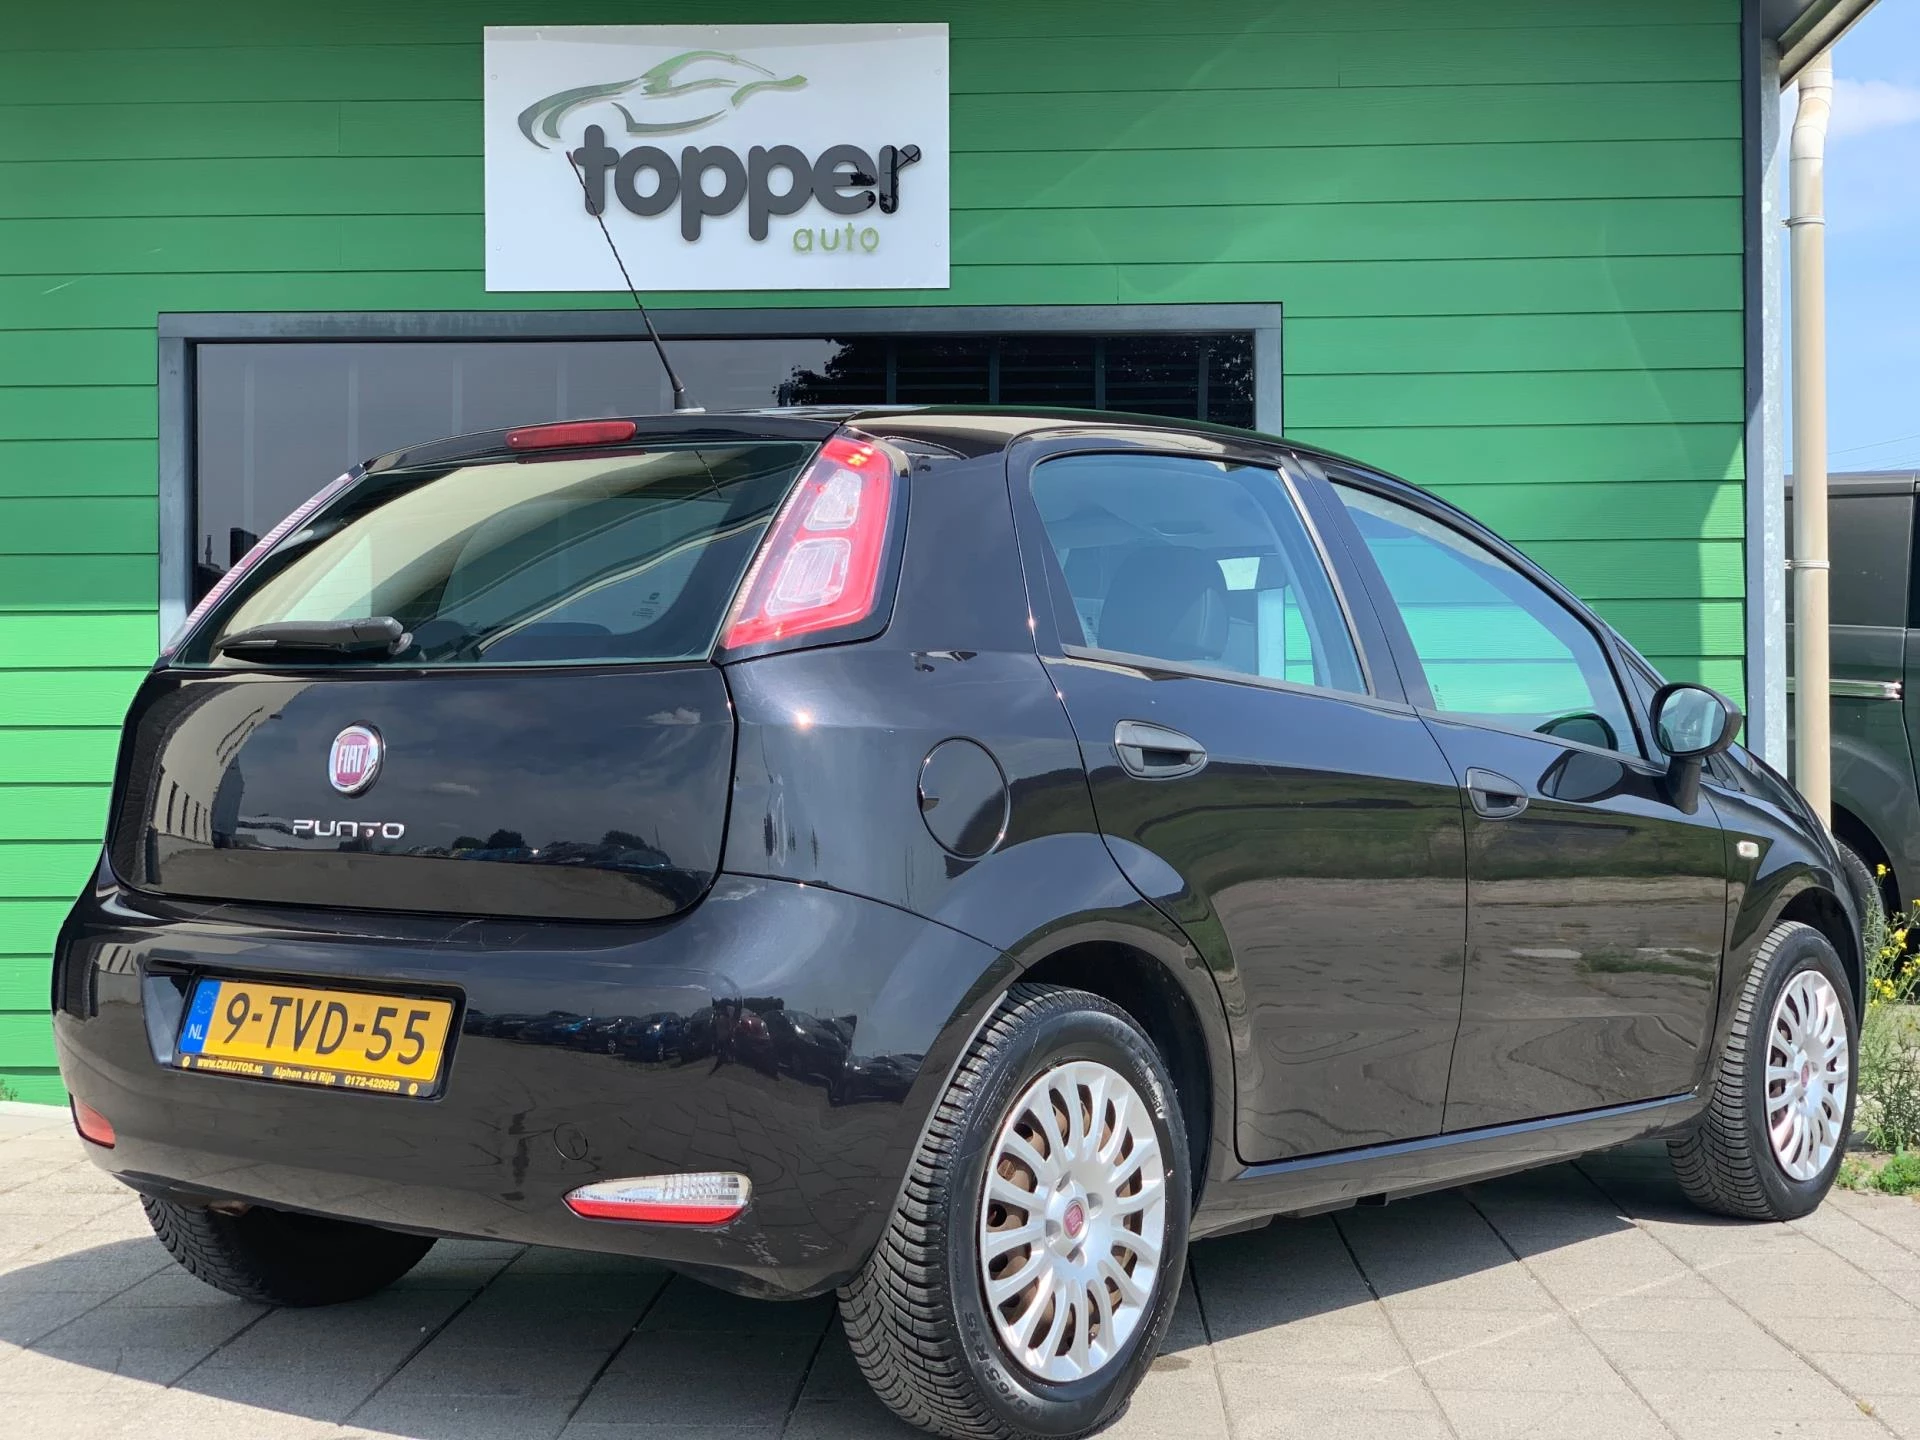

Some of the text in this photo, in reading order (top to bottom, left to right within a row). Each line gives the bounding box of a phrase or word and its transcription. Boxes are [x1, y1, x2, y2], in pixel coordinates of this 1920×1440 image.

[573, 124, 922, 242] topper
[793, 223, 880, 252] auto
[337, 744, 367, 773] FIAT
[293, 820, 405, 839] PUNTO
[188, 1023, 203, 1041] NL
[223, 992, 431, 1065] 9-TVD-55
[318, 1071, 336, 1084] Rijn
